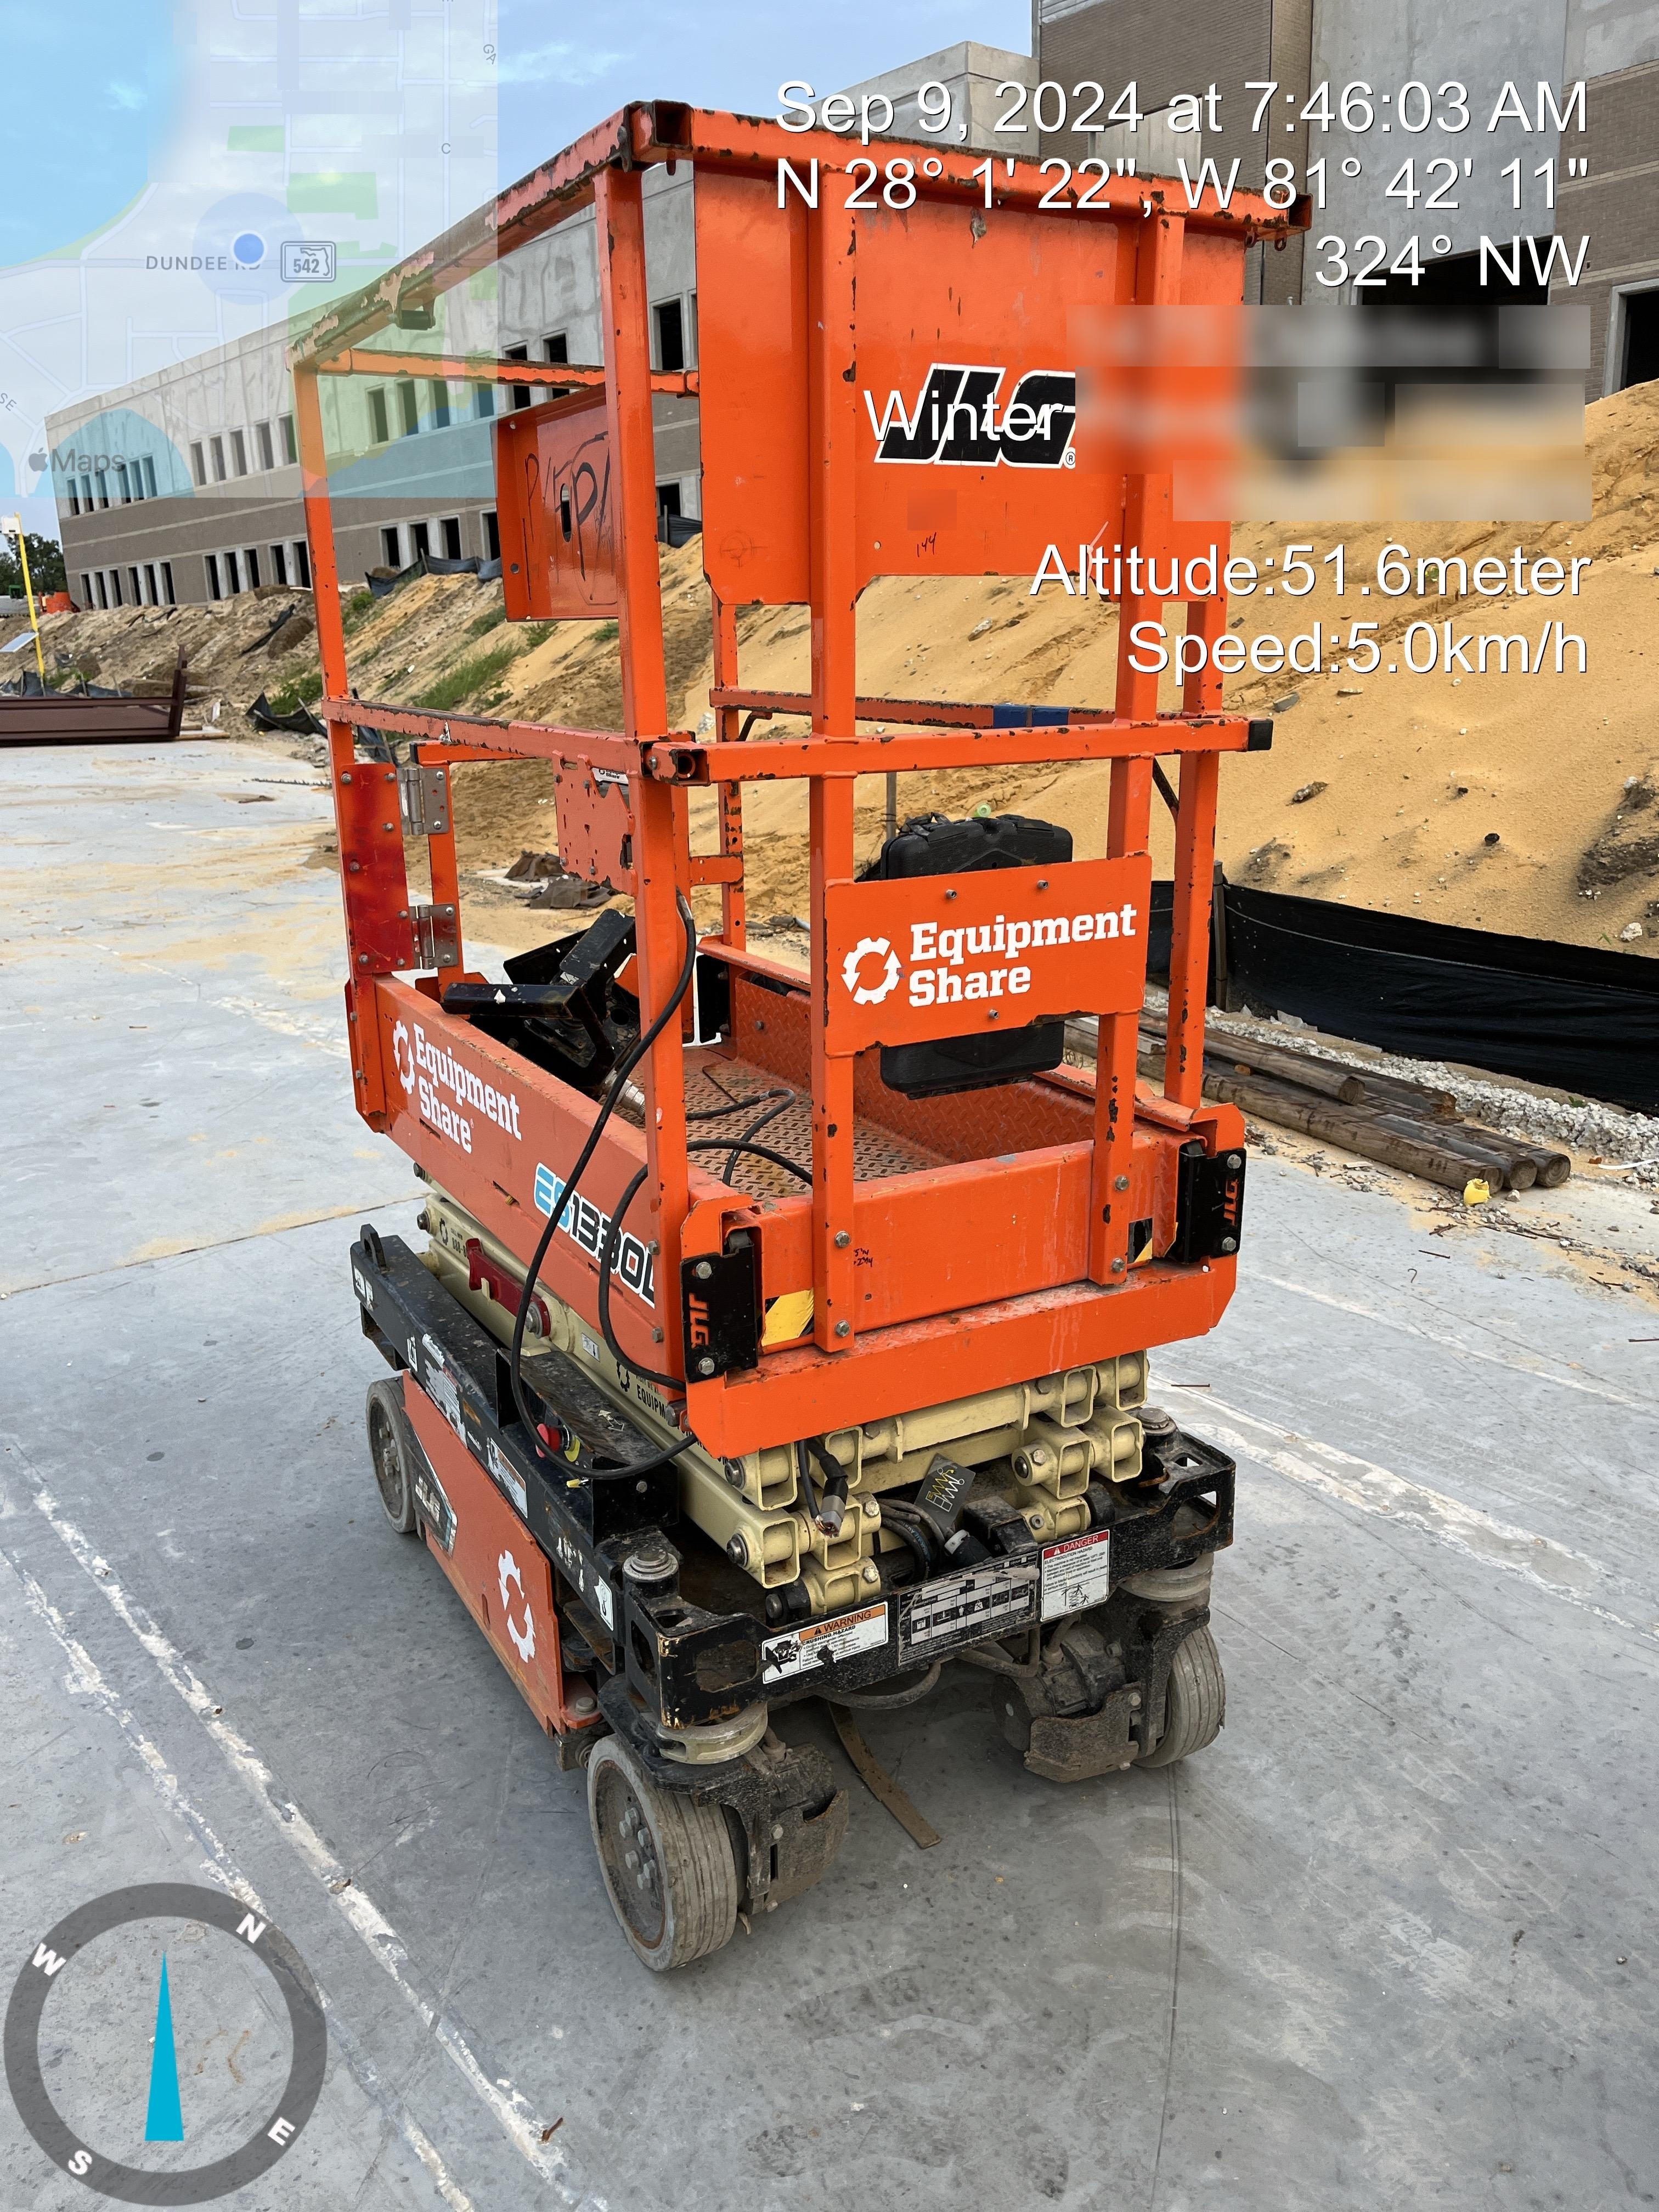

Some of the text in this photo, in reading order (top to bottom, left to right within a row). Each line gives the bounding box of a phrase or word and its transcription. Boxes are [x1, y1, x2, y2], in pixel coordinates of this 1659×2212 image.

[874, 363, 1075, 469] JLG
[910, 904, 1137, 966] Equipment
[909, 966, 1031, 1007] Share
[413, 1022, 522, 1142] Equipment
[418, 1075, 472, 1154] Share
[1223, 1178, 1239, 1227] JLG
[689, 1292, 710, 1349] JLG
[1045, 1551, 1077, 1565] ELECTROCUTION
[1063, 1535, 1099, 1552] DANGER
[802, 1633, 832, 1646] CRUSHING
[833, 1625, 856, 1635] HAZARD
[823, 1610, 871, 1632] WARNING
